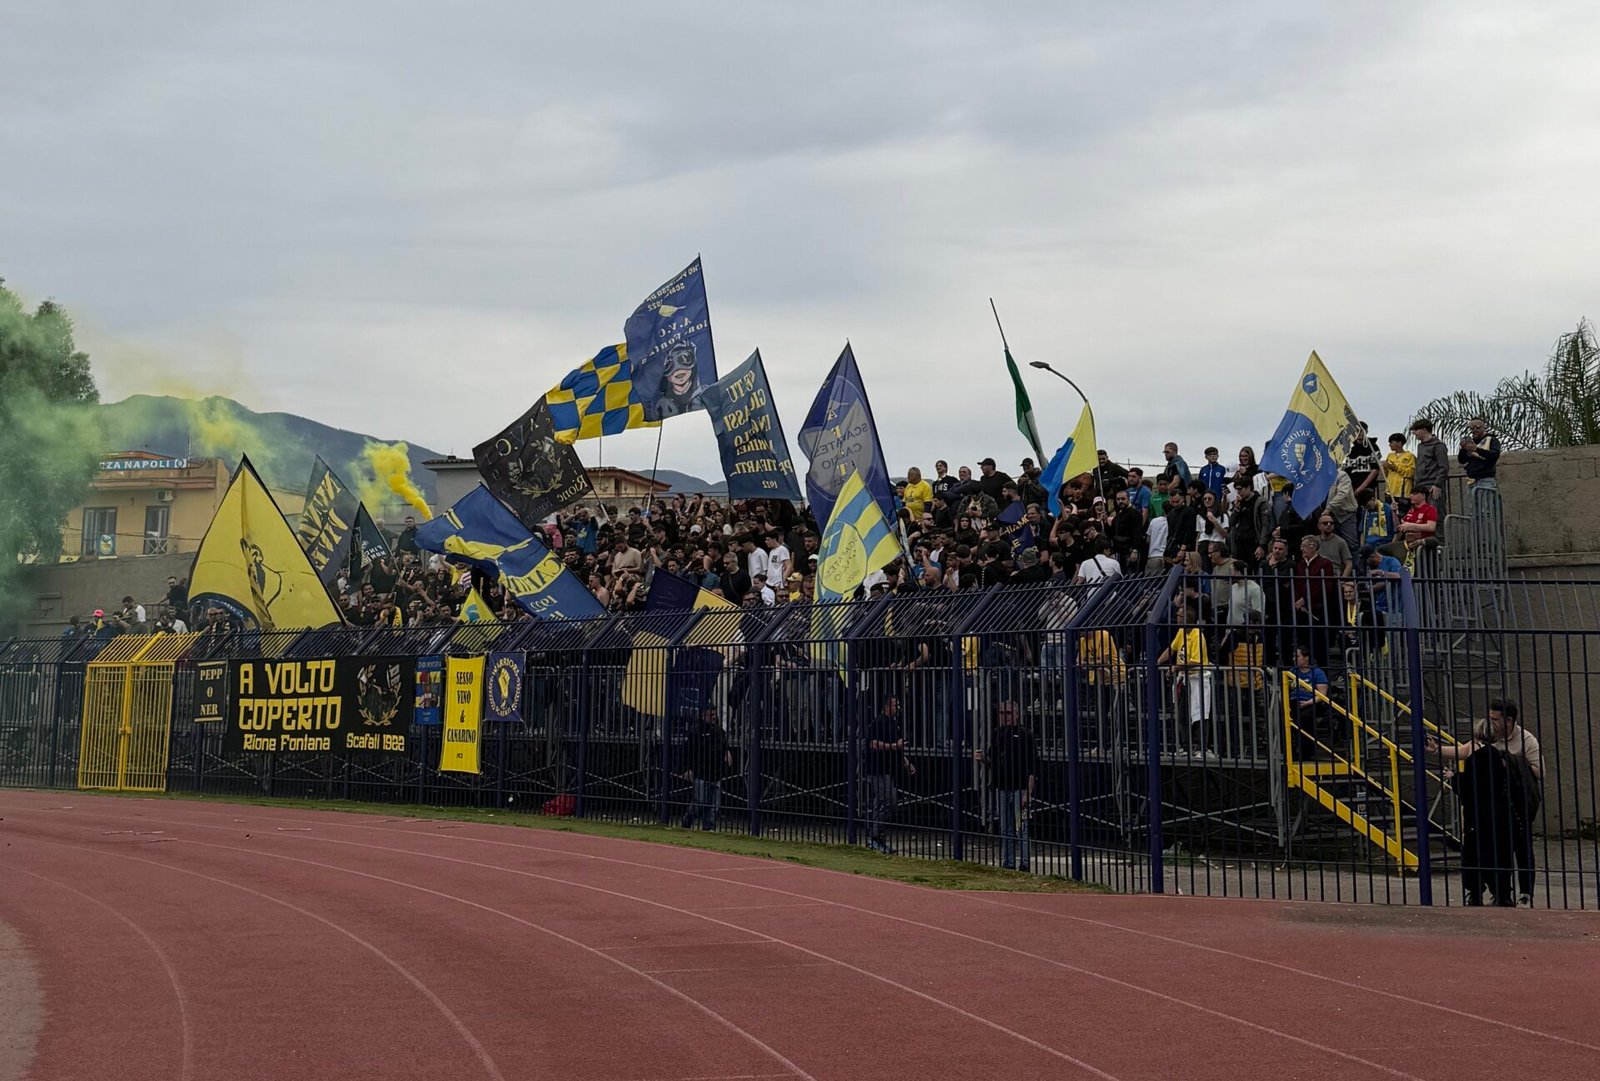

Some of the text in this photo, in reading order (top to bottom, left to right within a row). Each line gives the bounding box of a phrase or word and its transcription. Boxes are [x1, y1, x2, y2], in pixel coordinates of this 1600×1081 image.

[124, 460, 170, 469] NAPOLI
[200, 668, 223, 681] PEPP
[239, 660, 336, 694] A VOLTO
[456, 671, 474, 685] SESSO
[457, 690, 471, 704] VINO
[239, 696, 342, 731] COPERTO
[243, 733, 276, 751] Rione
[280, 733, 330, 751] Fontana
[383, 733, 405, 752] 1922
[447, 728, 476, 744] CANARINO
